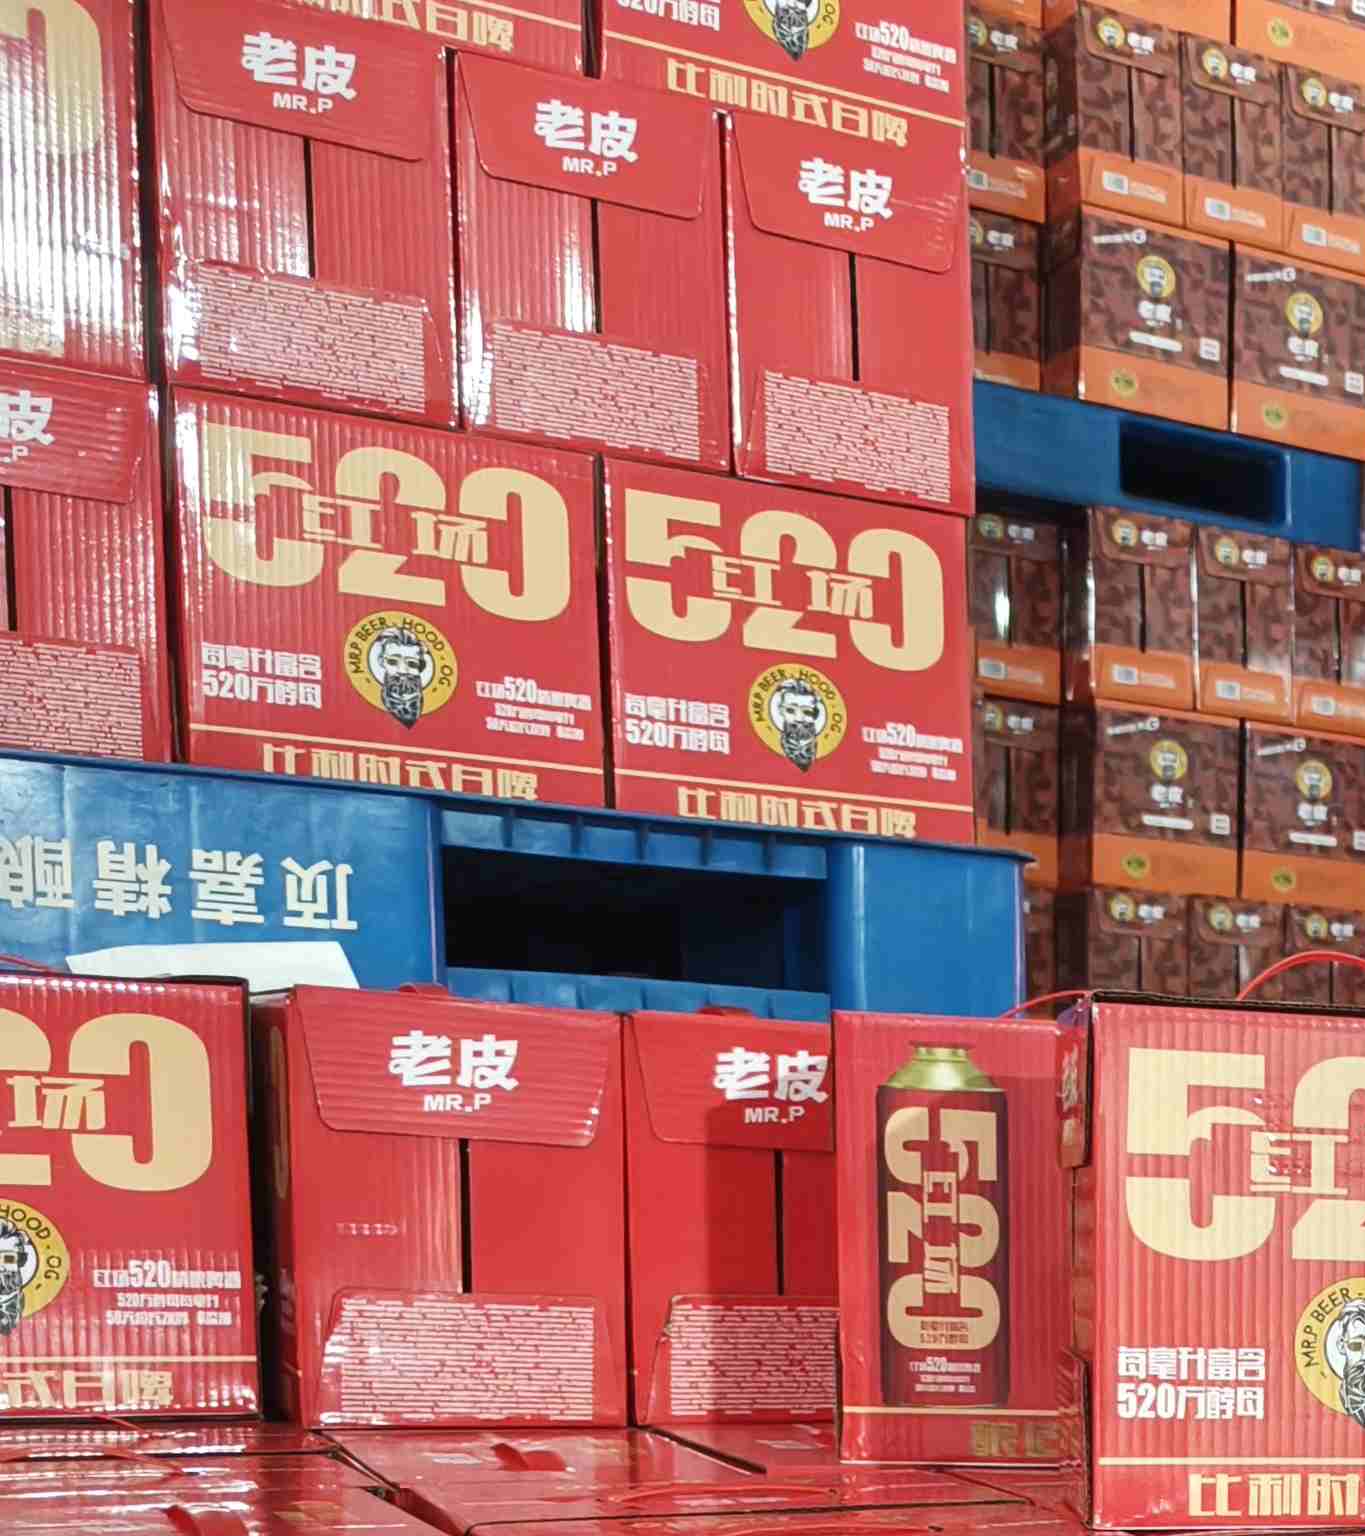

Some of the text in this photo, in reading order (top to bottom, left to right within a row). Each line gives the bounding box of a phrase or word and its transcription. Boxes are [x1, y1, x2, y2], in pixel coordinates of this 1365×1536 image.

[242, 31, 358, 100] 老皮
[273, 92, 334, 114] MR.P
[666, 58, 908, 147] 比利时式白啤
[534, 99, 639, 162] 老皮
[562, 156, 617, 177] MR.P
[798, 157, 893, 219] 老皮
[823, 211, 875, 232] MR.P
[199, 422, 570, 623] 520
[301, 494, 488, 564] 红场
[623, 486, 944, 673] 520
[712, 553, 873, 617] 红场
[355, 616, 387, 641] BEER
[402, 617, 445, 652] HOOD
[201, 642, 321, 680] 每毫升富含
[202, 671, 321, 708] 520万酵母
[625, 719, 730, 754] 520万酵母
[263, 743, 538, 799] 比利时式白啤
[677, 787, 916, 838] 比利时式白啤
[389, 1029, 519, 1091] 老皮
[712, 1047, 828, 1105] 老皮
[423, 1093, 491, 1113] MR.P
[744, 1105, 804, 1125] MR.P
[884, 1106, 1000, 1350] 520
[923, 1171, 958, 1293] 红场
[1313, 1287, 1352, 1322] BEER
[1117, 1347, 1266, 1381] 每毫升富含
[1117, 1384, 1264, 1420] 520万酵母
